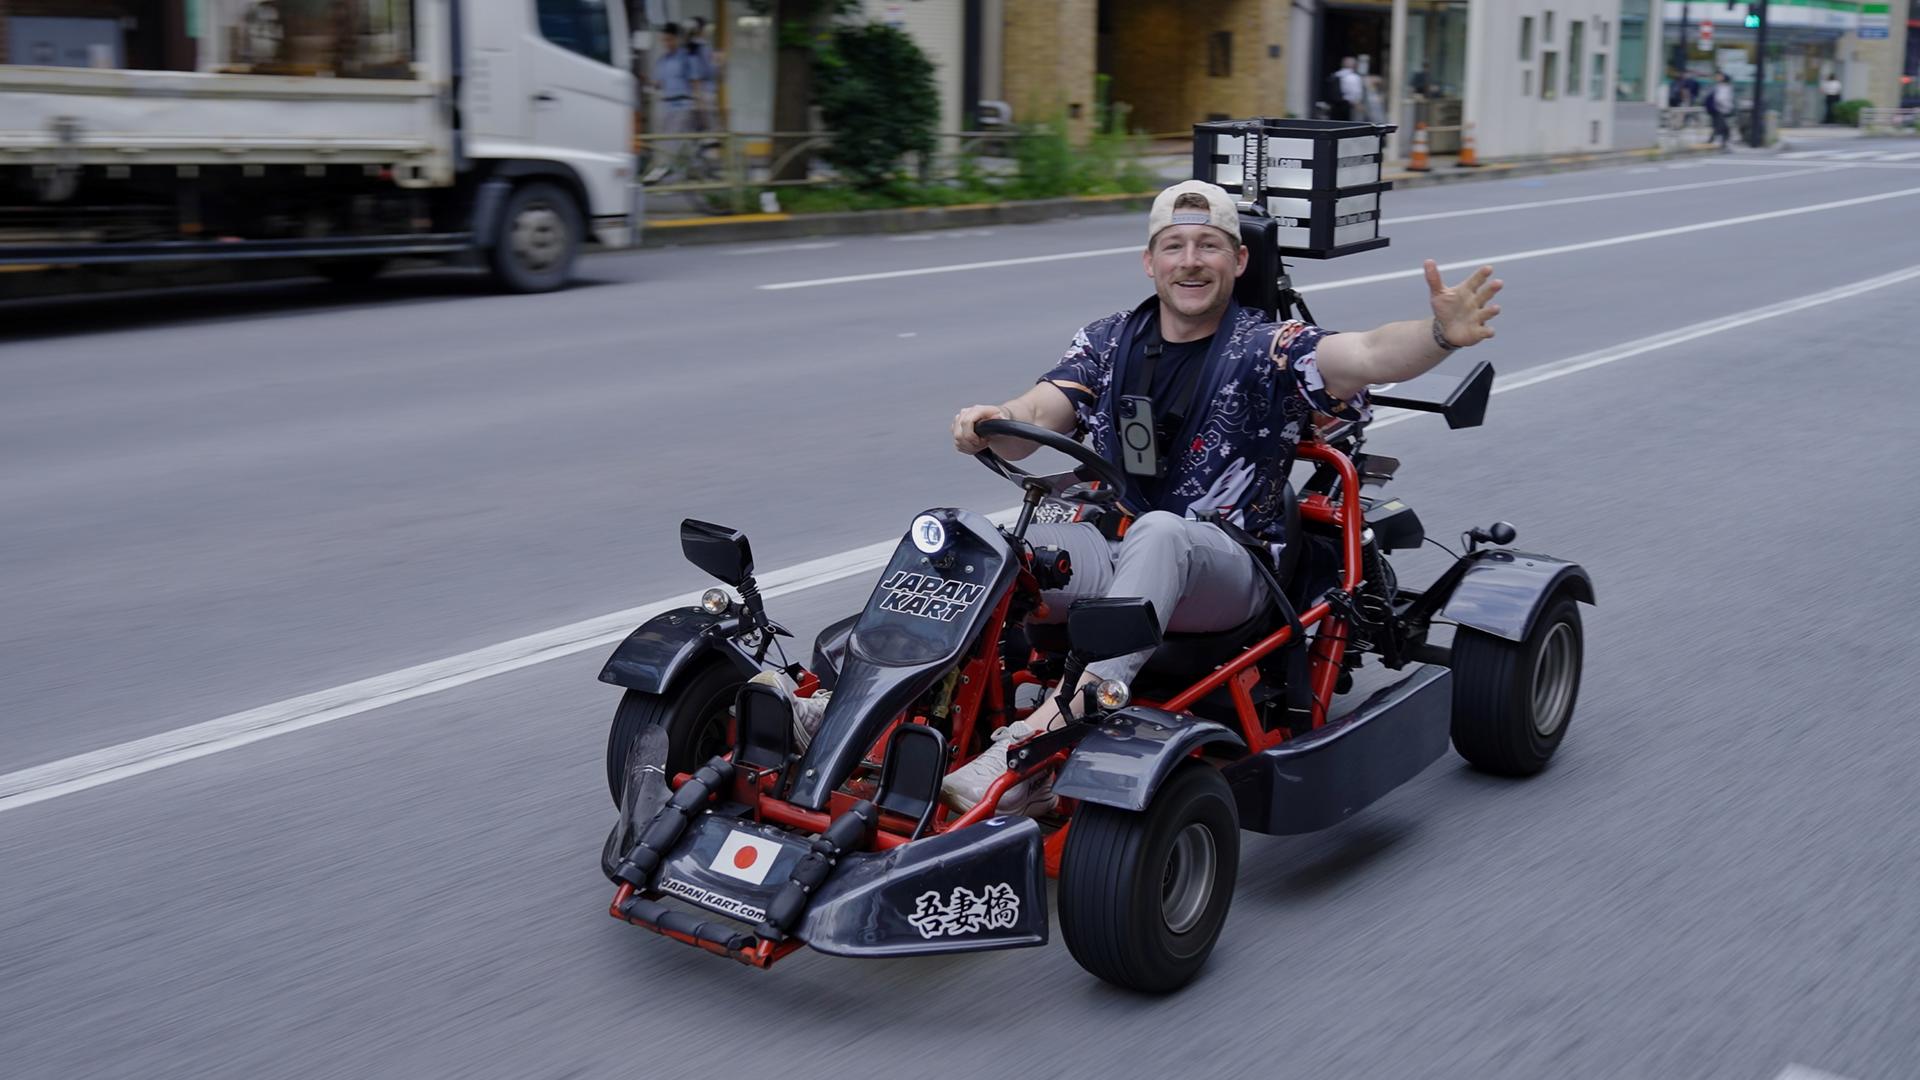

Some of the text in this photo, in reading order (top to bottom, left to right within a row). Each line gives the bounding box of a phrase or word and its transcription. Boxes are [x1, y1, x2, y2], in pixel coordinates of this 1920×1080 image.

[881, 571, 986, 605] JAPAN
[880, 591, 968, 621] KART
[908, 883, 1020, 939] 吾妻橋
